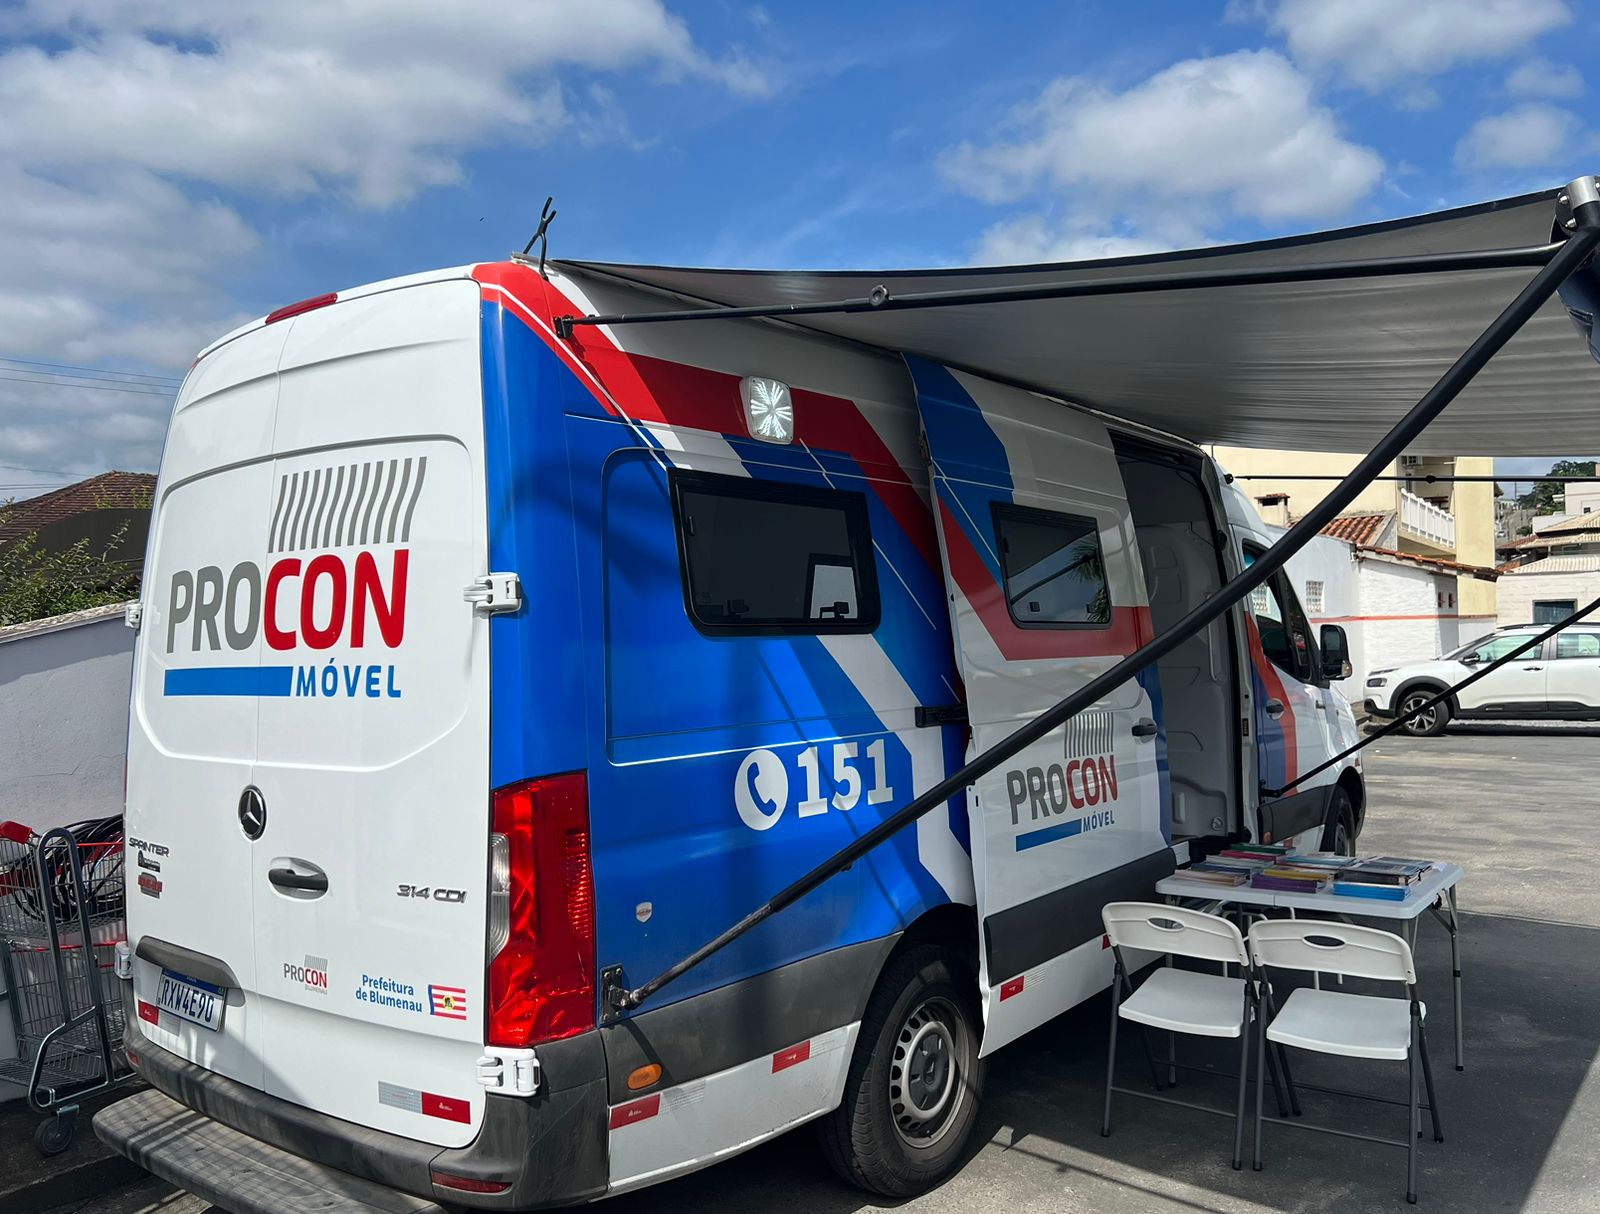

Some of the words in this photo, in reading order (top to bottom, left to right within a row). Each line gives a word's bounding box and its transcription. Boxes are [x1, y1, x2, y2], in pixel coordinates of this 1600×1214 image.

[166, 548, 410, 654] PROCON
[296, 657, 402, 698] MÓVEL
[797, 738, 894, 819] 151
[1006, 754, 1118, 826] PROCON
[1082, 809, 1116, 833] MÓVEL
[128, 836, 170, 858] SPRINTER
[397, 884, 430, 900] 314
[433, 888, 467, 904] CDI
[283, 962, 328, 989] PROCON
[362, 974, 415, 996] Prefeitura
[160, 978, 215, 1023] RXW4E90
[355, 986, 368, 1001] de
[369, 990, 423, 1013] Blumenau
